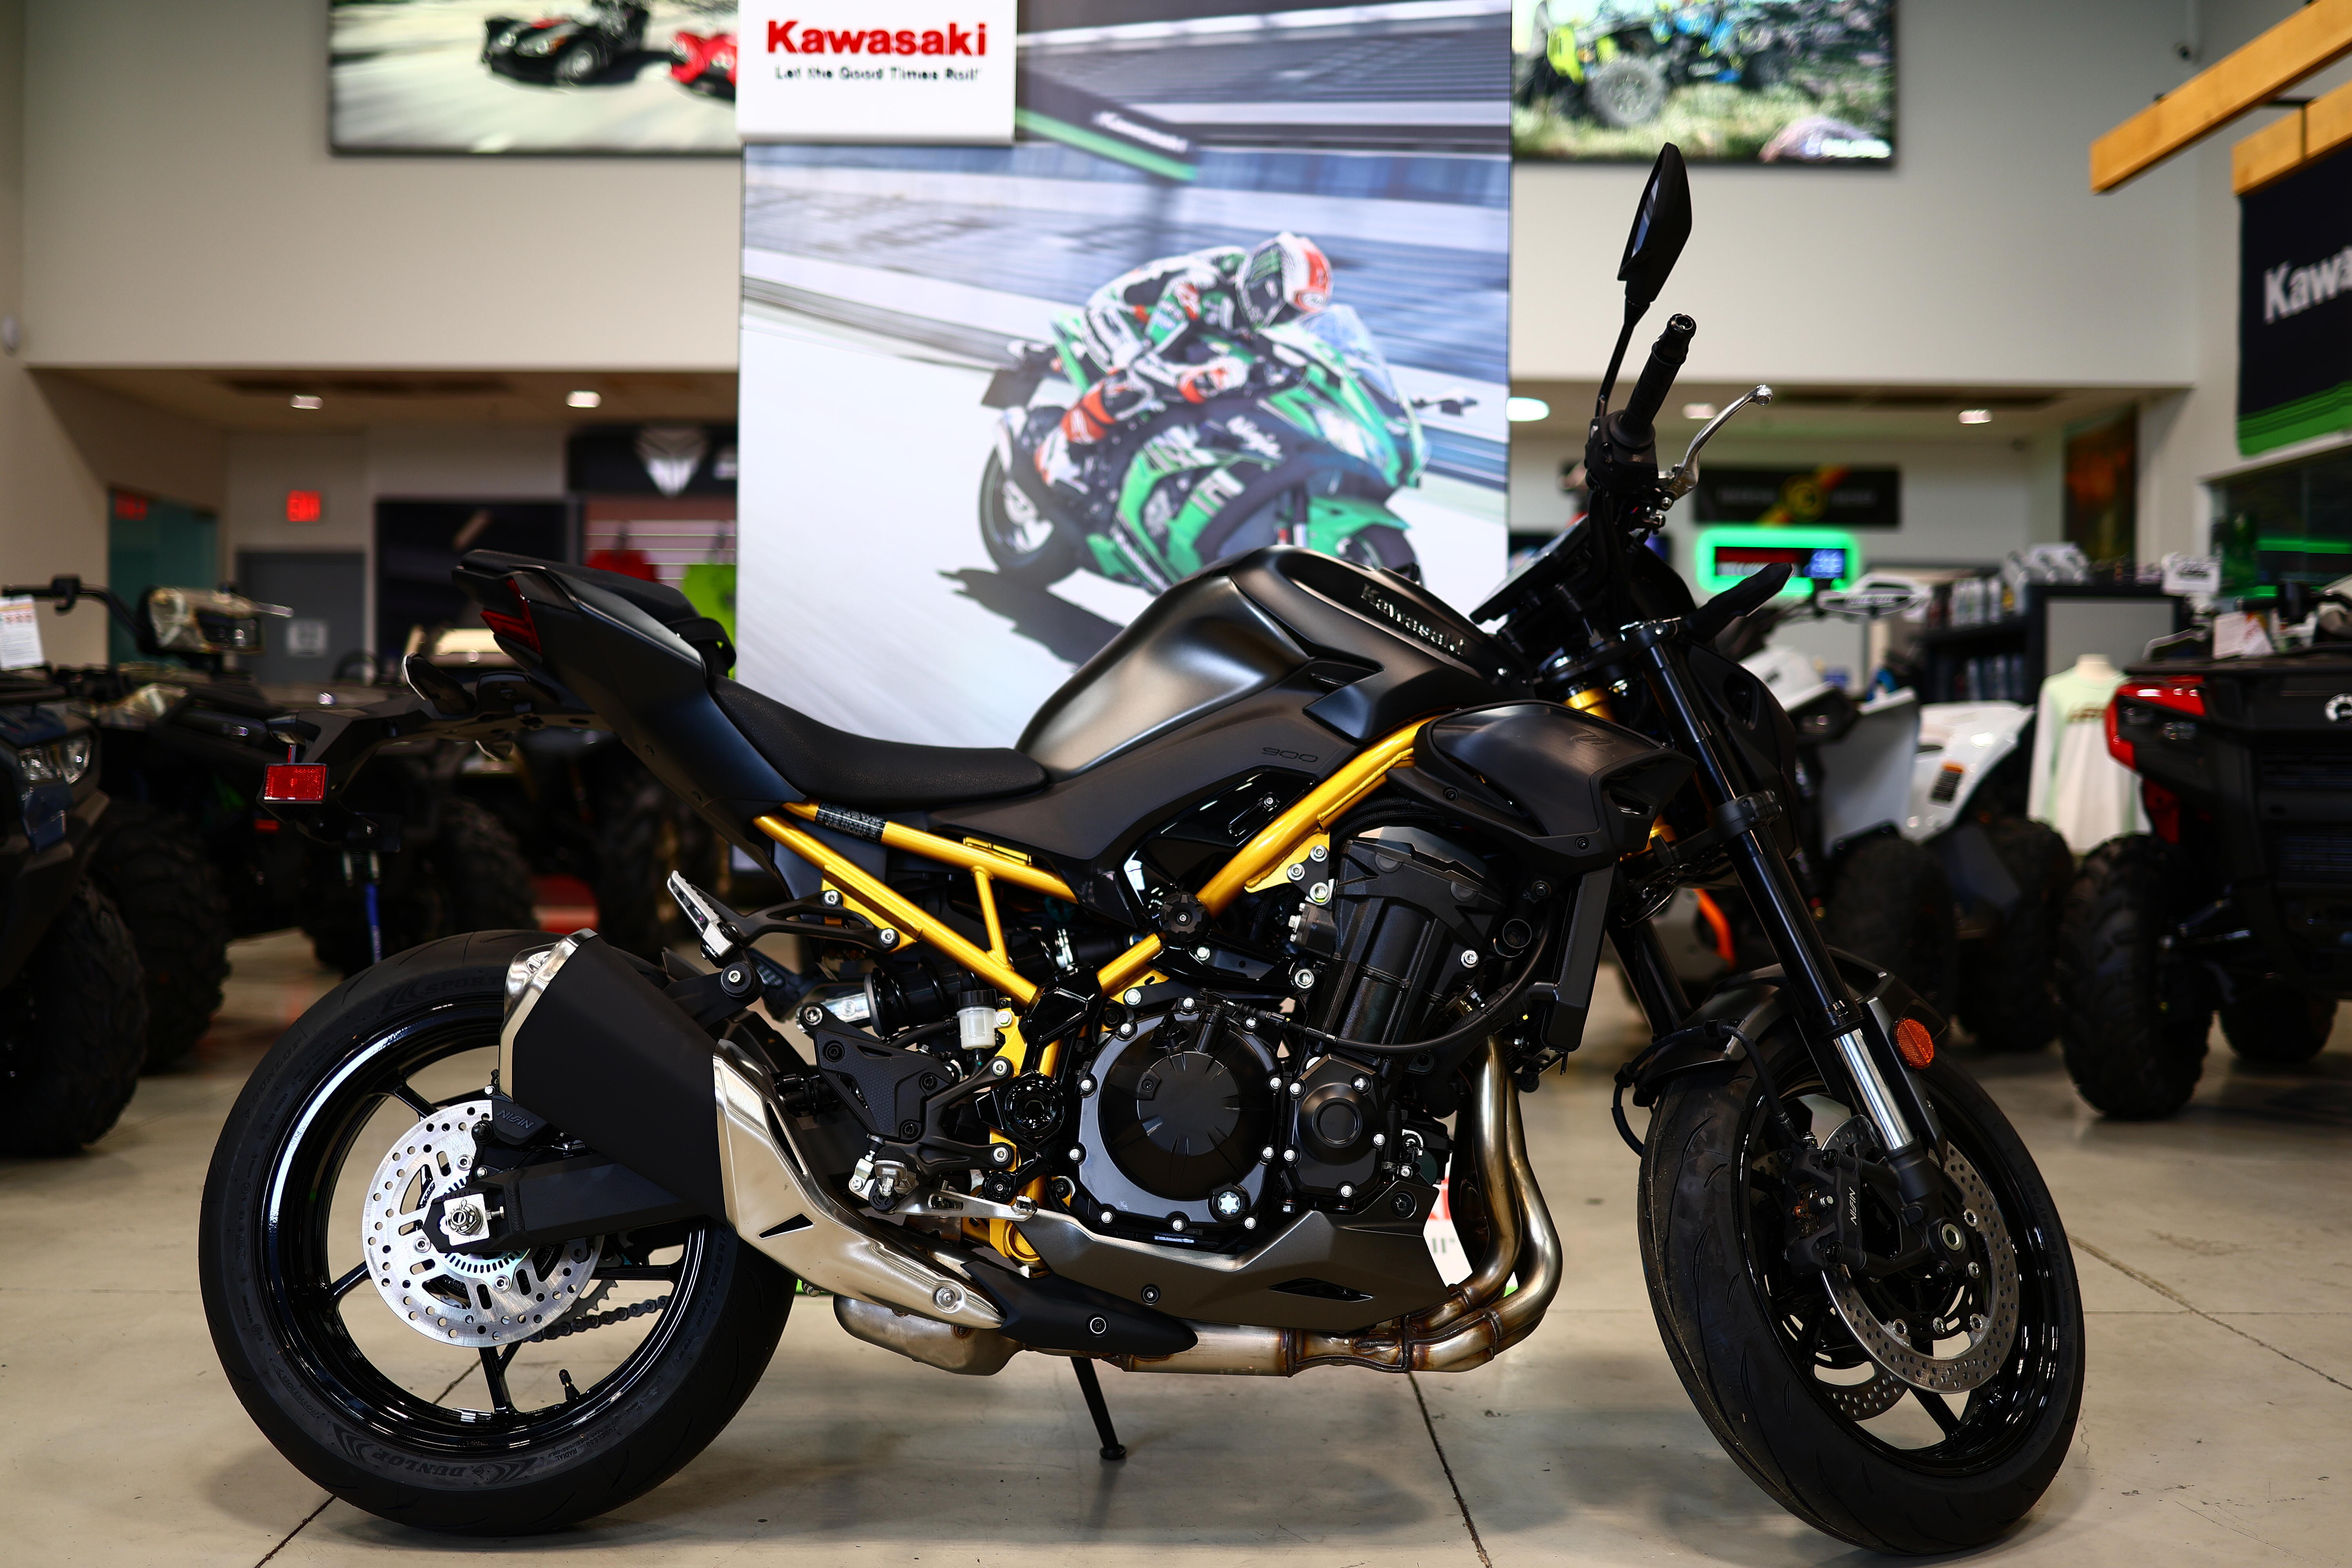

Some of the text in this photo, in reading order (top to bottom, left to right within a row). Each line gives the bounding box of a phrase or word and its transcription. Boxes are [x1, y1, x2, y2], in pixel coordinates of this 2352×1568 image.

[768, 20, 986, 56] Kawasaki
[776, 66, 800, 80] Let
[808, 66, 833, 80] the
[840, 67, 883, 80] Good
[891, 67, 937, 80] Times
[1360, 583, 1465, 656] Kawasaki
[1261, 747, 1318, 762] 900
[278, 1374, 322, 1418] ROTATION
[547, 1449, 561, 1458] ONLY
[555, 1425, 617, 1461] TUBELESS RADIAL
[371, 1451, 467, 1477] DUNLOP
